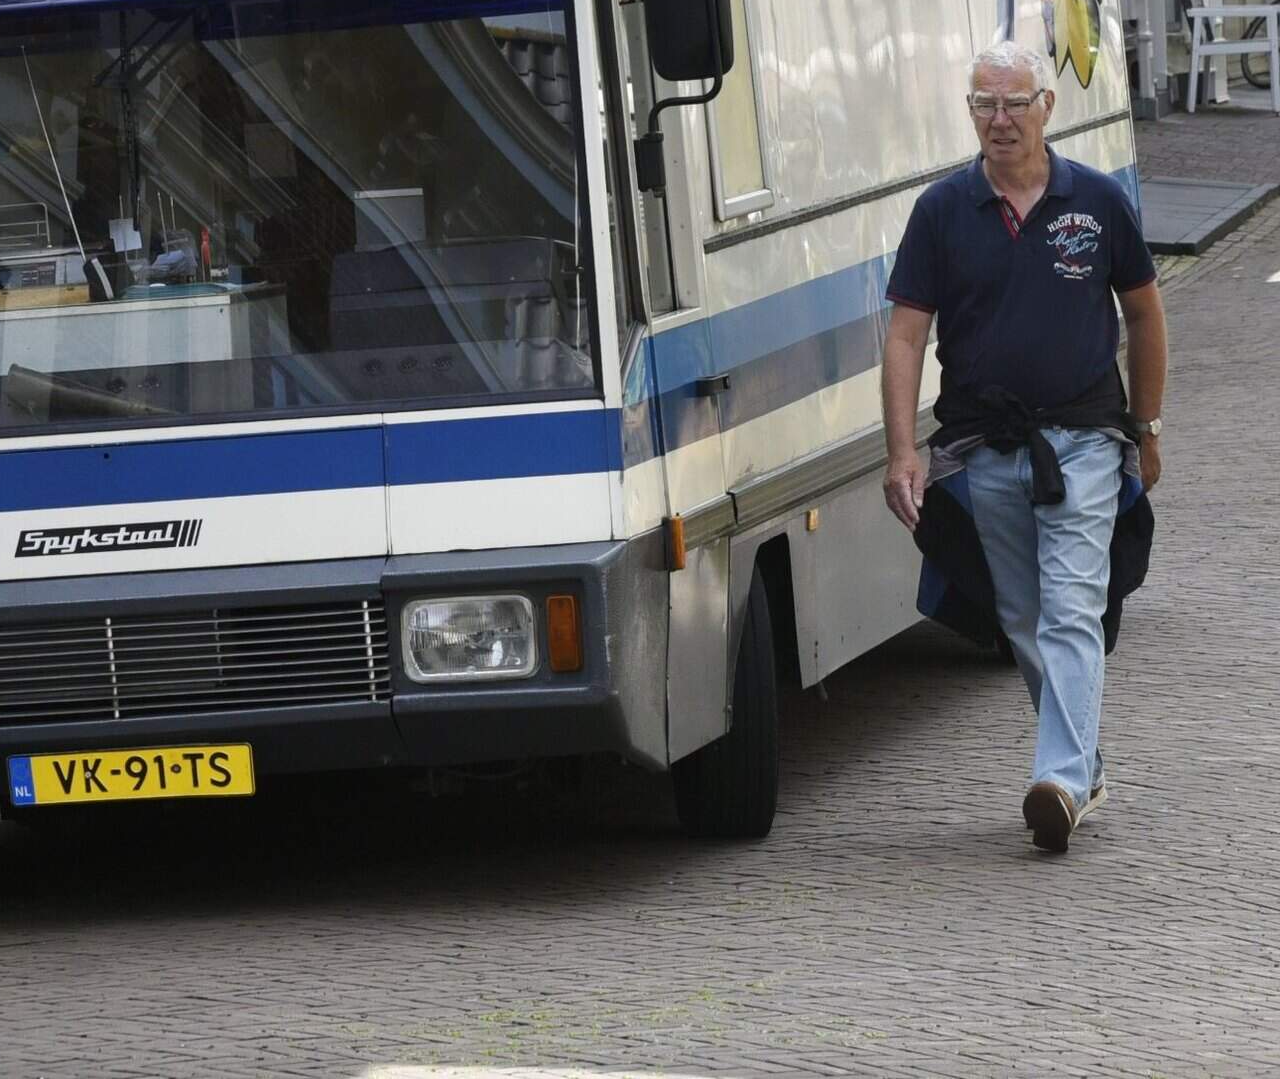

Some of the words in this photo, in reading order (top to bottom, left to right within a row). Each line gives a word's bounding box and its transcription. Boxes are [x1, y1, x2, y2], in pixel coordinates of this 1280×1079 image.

[1046, 215, 1072, 233] HIGH
[1073, 215, 1102, 234] WINDS
[21, 523, 175, 555] Spykstaal
[14, 786, 32, 798] NL
